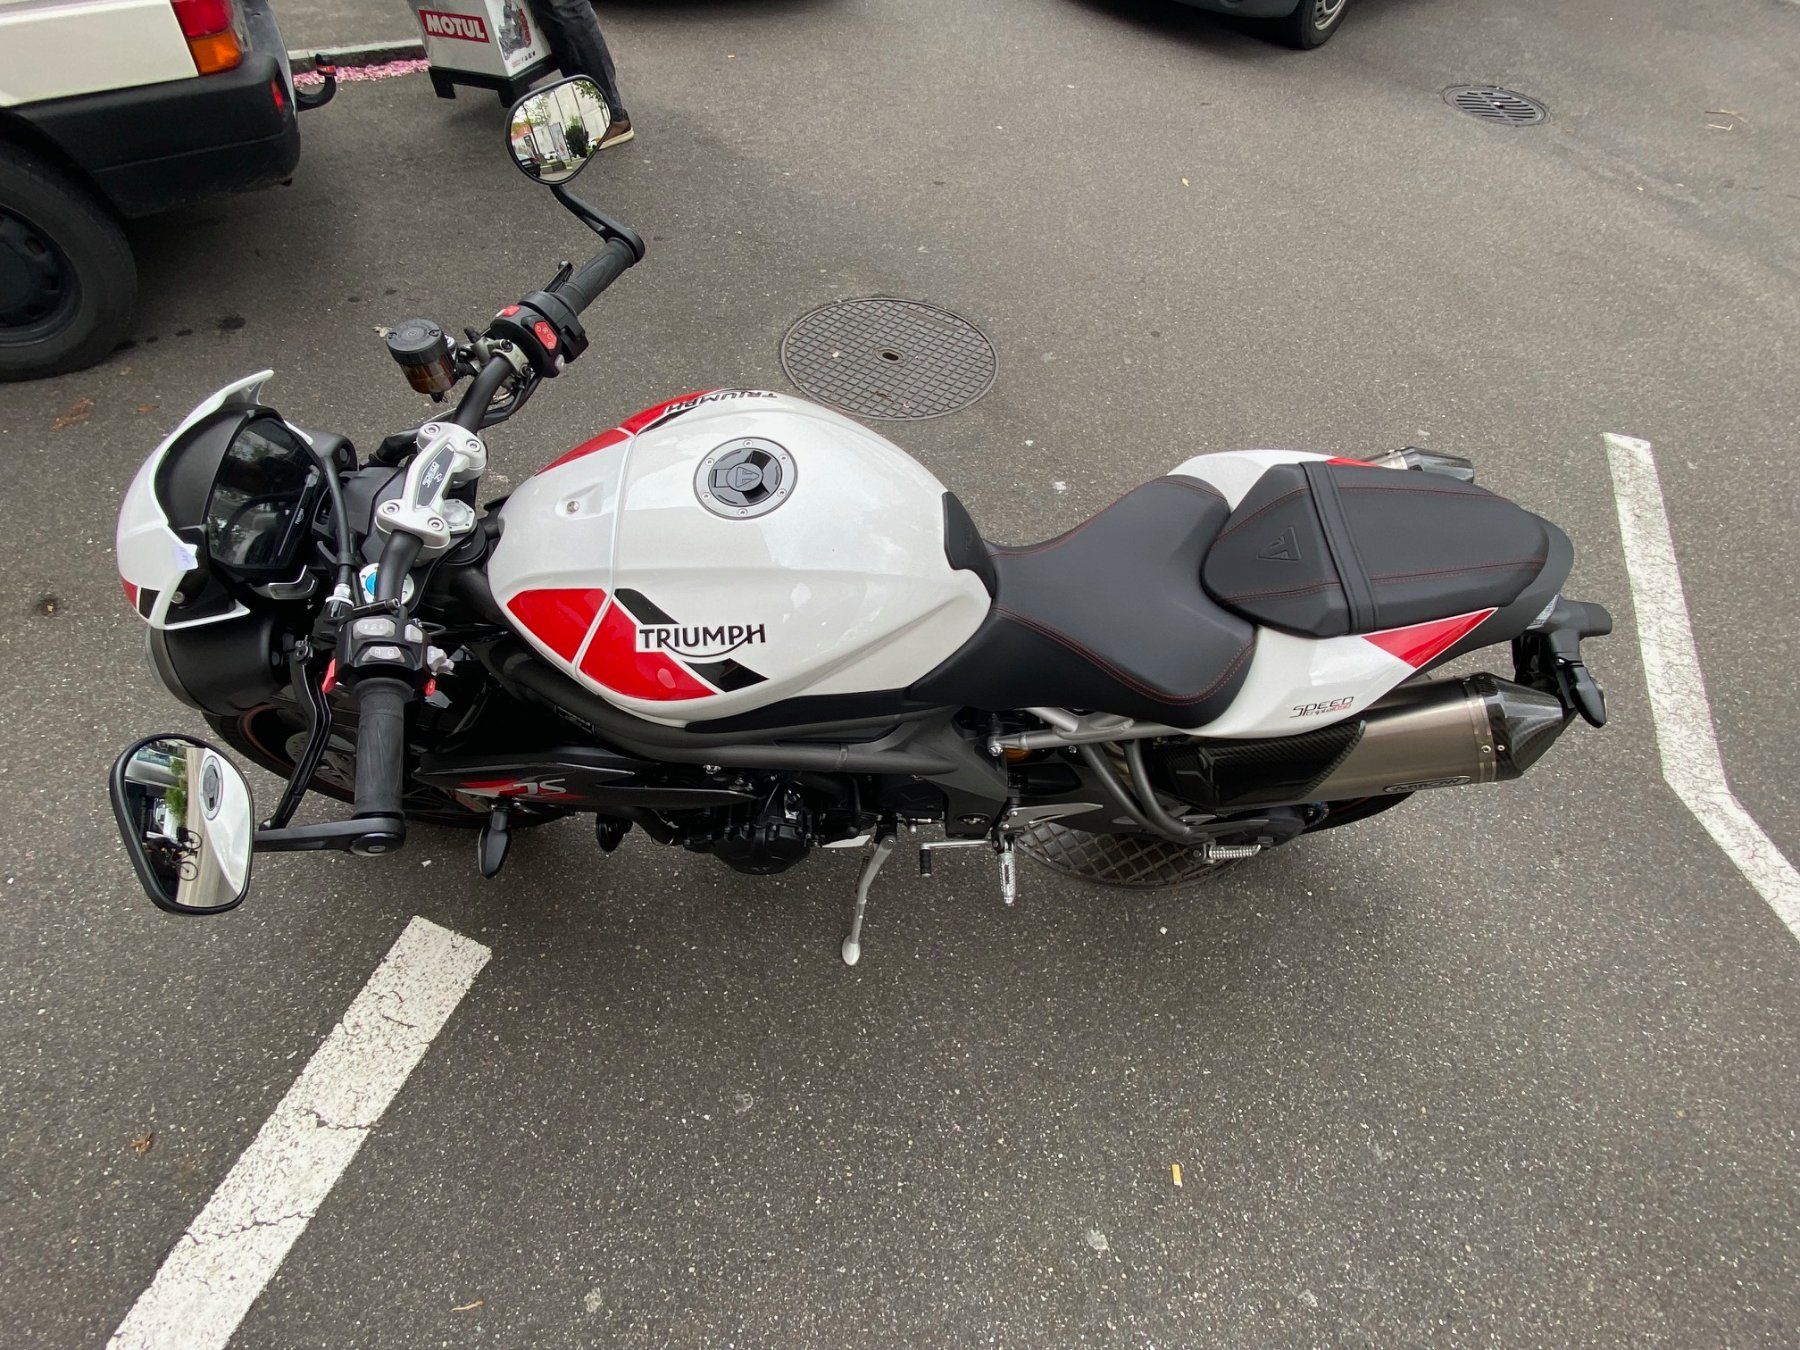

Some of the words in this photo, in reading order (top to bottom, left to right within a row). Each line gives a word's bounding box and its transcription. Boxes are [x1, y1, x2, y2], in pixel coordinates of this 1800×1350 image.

[427, 14, 485, 39] MOTUL
[639, 624, 766, 658] TRIUMPH
[1289, 696, 1354, 718] SPEED
